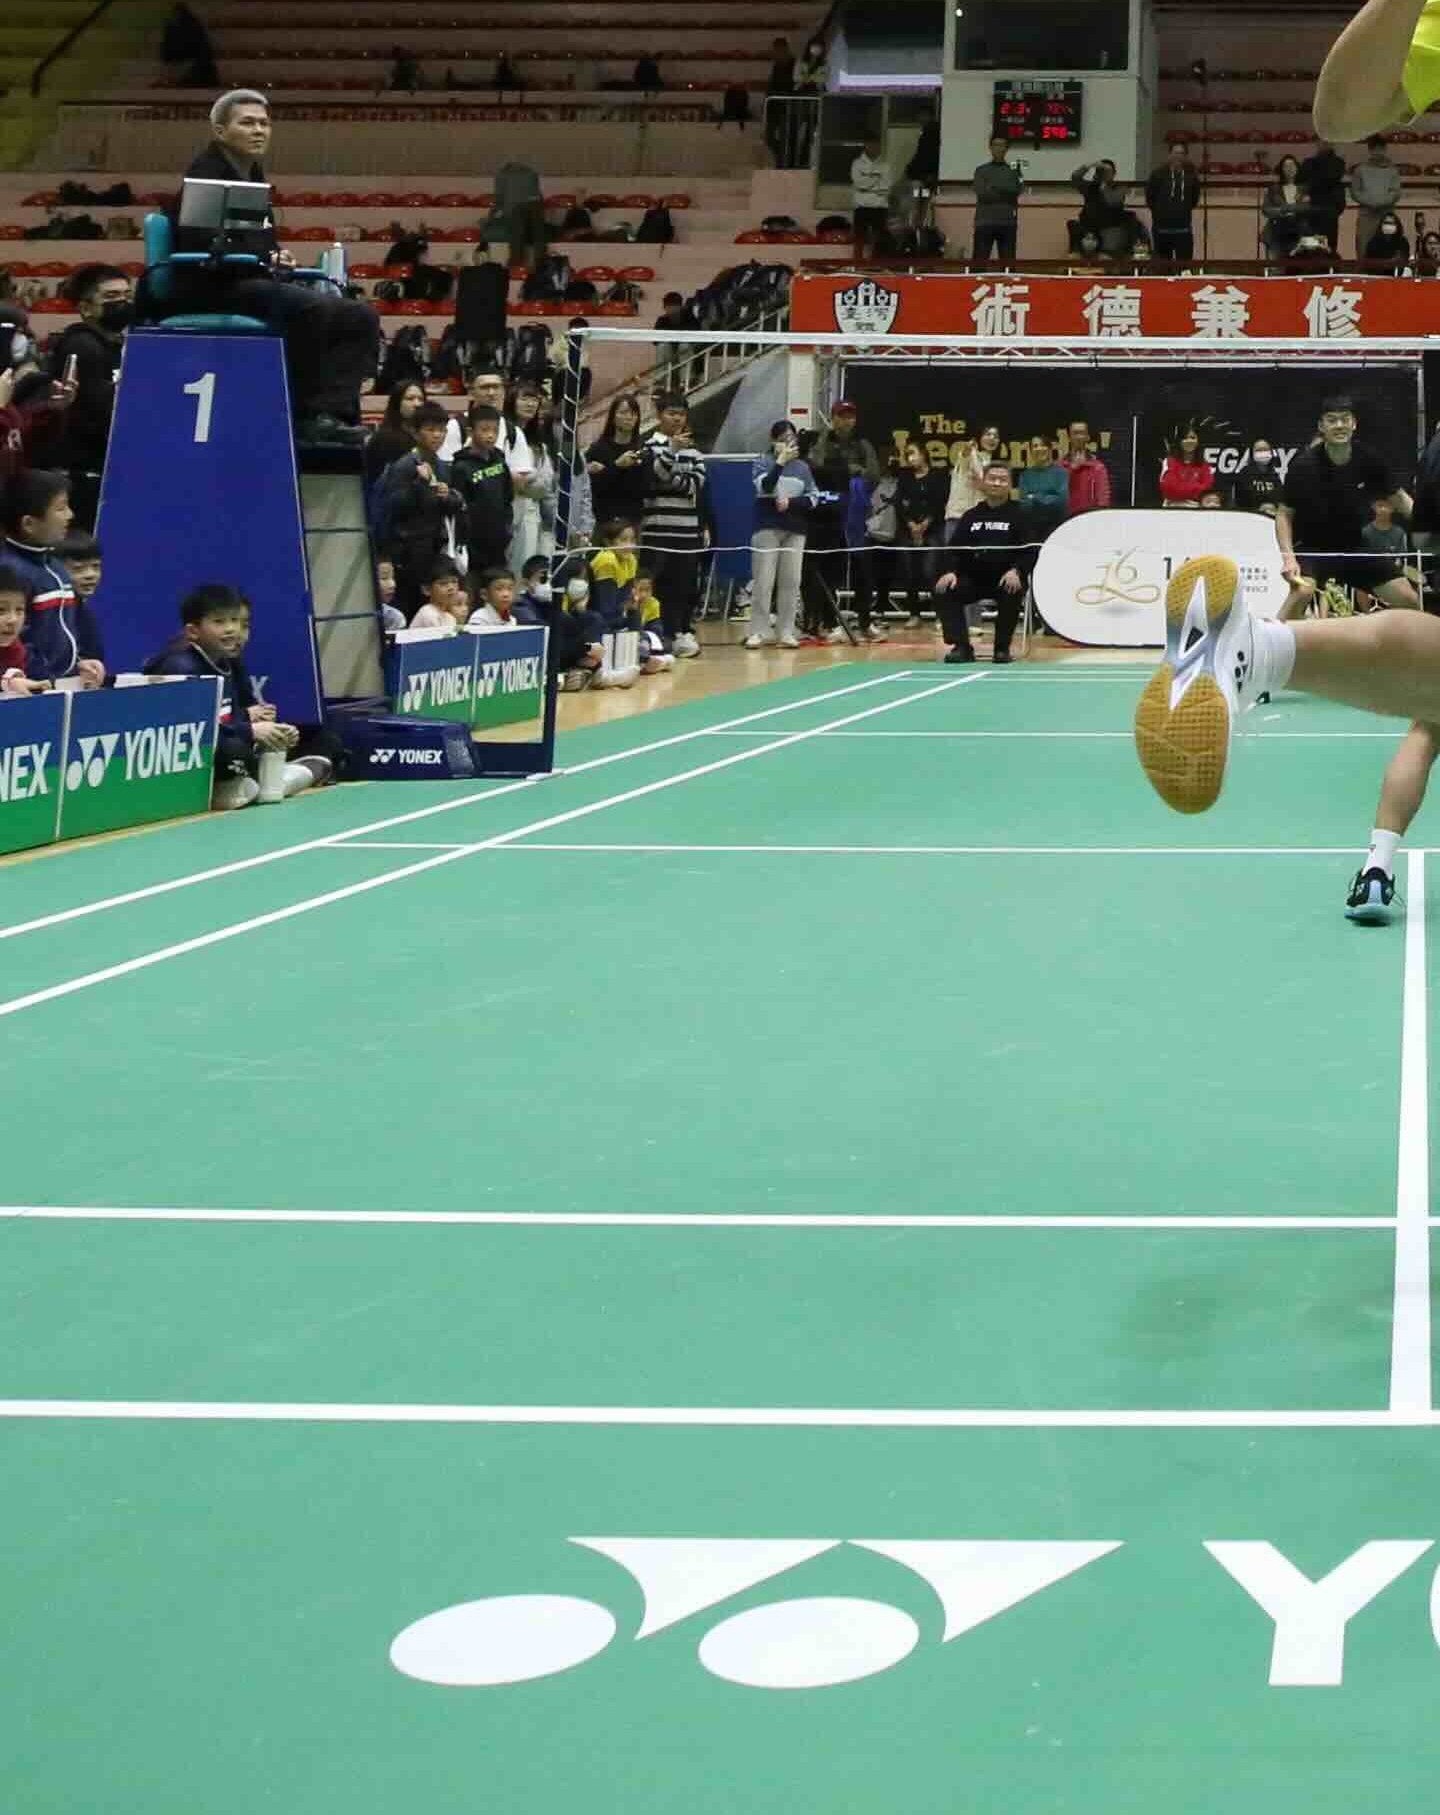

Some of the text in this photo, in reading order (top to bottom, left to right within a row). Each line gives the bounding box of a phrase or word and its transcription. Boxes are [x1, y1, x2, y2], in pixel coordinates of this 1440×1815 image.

[184, 372, 216, 443] 1
[919, 413, 966, 434] The
[430, 665, 472, 707] YONEX
[502, 656, 540, 694] YONEX
[121, 721, 206, 782] YONEX
[398, 749, 443, 765] YONEX
